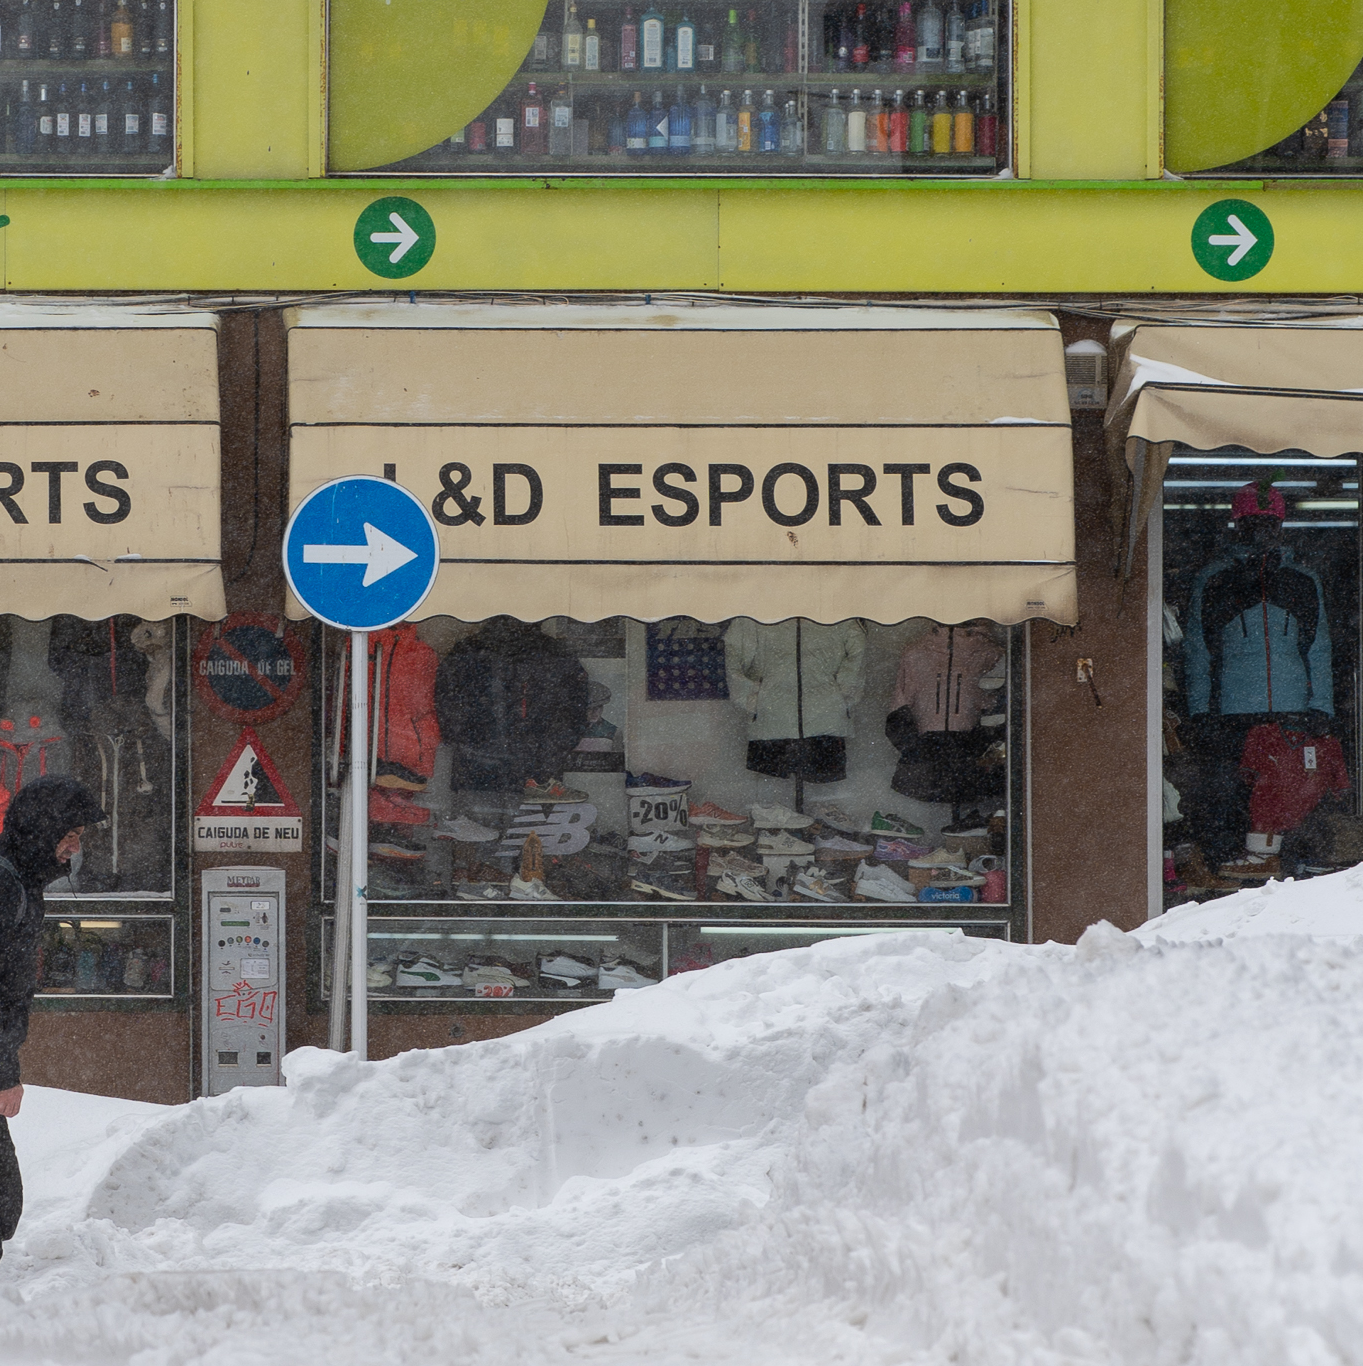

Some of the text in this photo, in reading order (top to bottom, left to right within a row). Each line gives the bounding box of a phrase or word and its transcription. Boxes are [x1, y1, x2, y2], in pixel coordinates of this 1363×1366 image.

[598, 462, 984, 527] ESPORTS
[199, 660, 249, 676] CAIGUDA
[276, 659, 297, 675] GEL
[633, 793, 688, 827] -20%
[198, 826, 300, 840] CAIGUDA DE NEU
